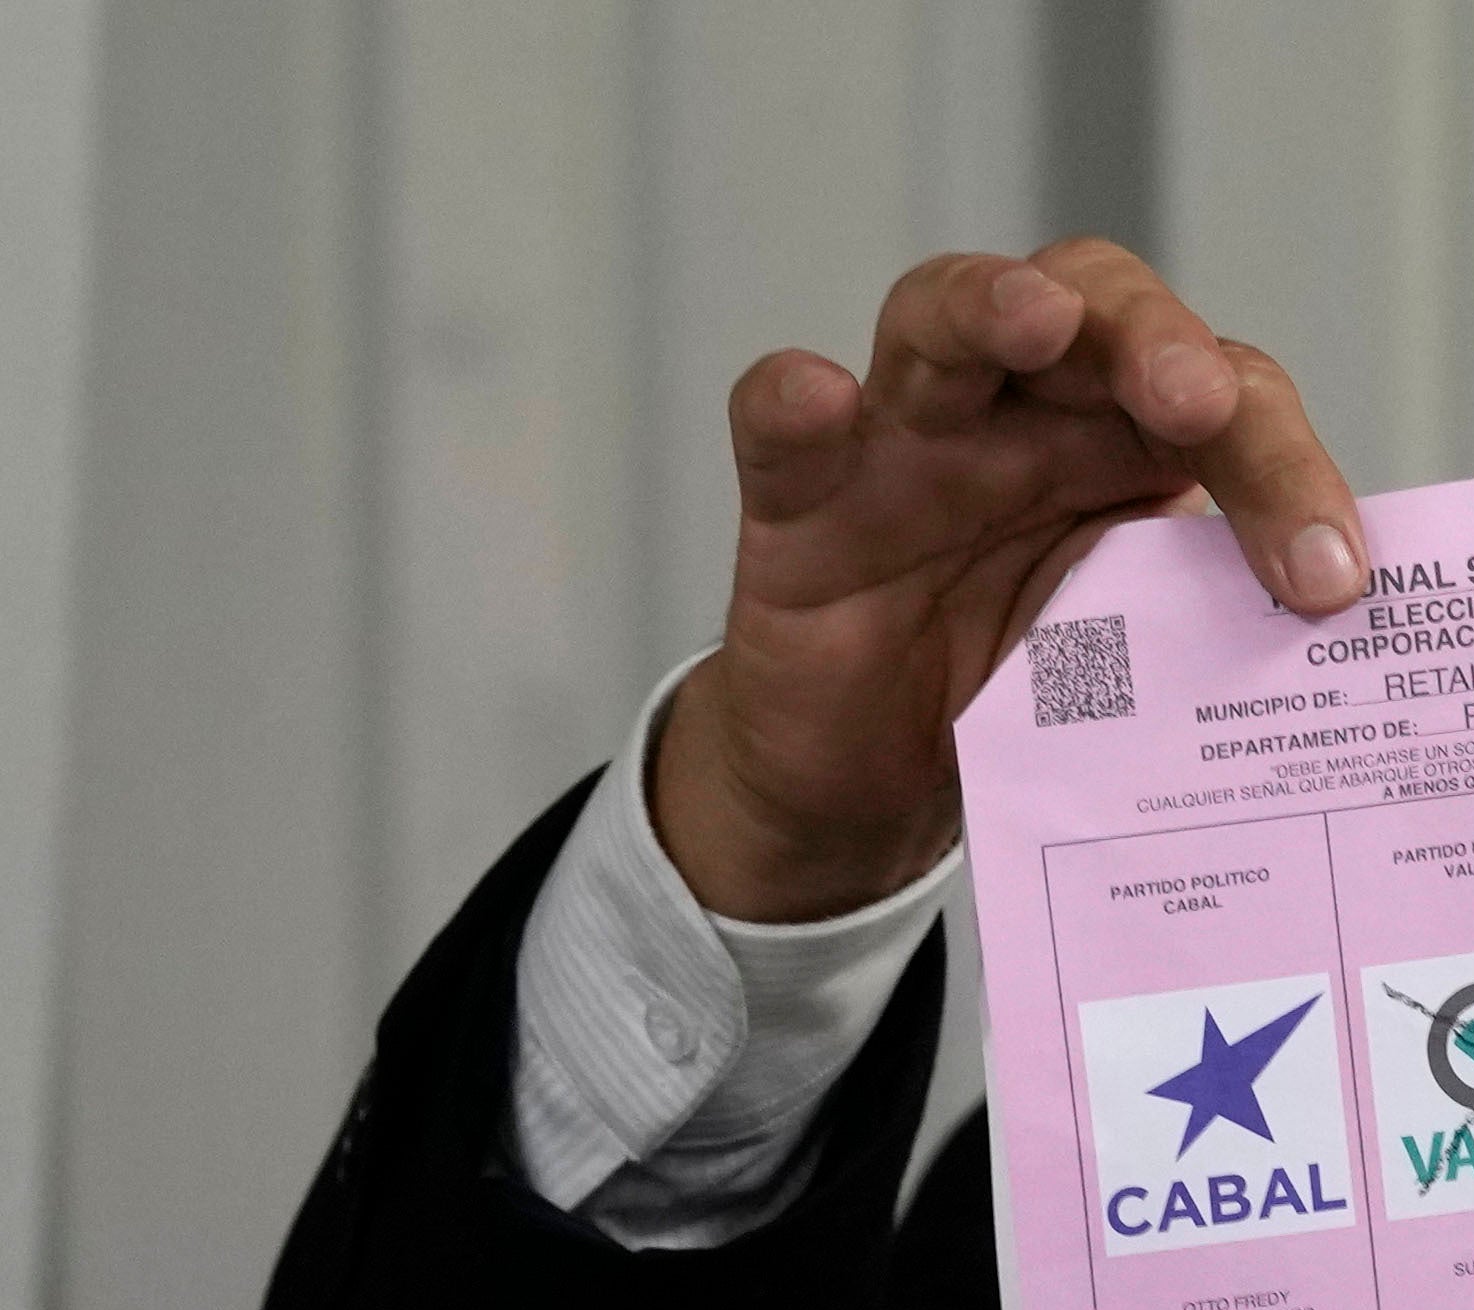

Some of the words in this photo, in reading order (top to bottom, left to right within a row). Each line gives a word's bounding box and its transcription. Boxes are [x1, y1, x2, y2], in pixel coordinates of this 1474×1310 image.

[1195, 694, 1307, 724] MUNICIPIO
[1312, 690, 1348, 709] DE:
[1200, 724, 1377, 762] DEPARTAMENTO
[1382, 719, 1419, 739] DE:
[1383, 785, 1395, 800] A
[1398, 777, 1460, 798] MENOS
[1393, 842, 1467, 865] PARTIDO
[1110, 878, 1187, 901] PARTIDO
[1190, 867, 1270, 891] POLITICO
[1163, 894, 1223, 915] CABAL
[1106, 1163, 1348, 1237] CABAL
